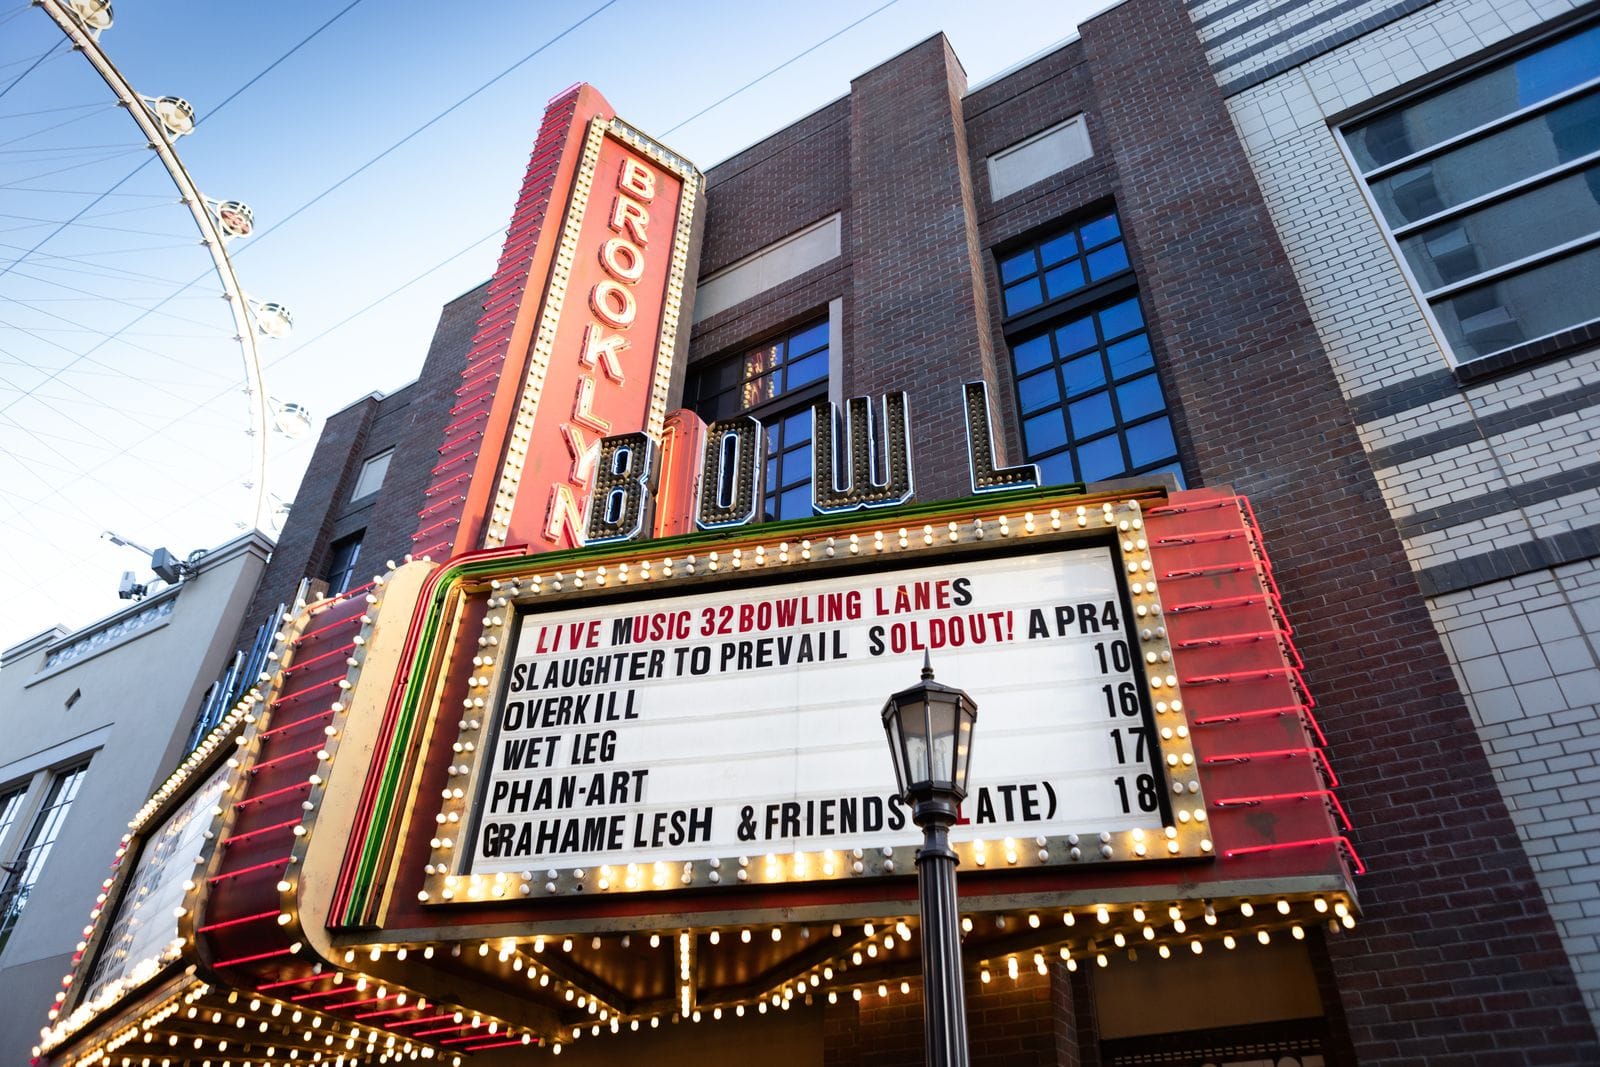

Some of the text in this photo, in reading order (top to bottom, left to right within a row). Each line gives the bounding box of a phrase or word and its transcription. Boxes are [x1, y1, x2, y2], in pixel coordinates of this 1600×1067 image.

[544, 156, 657, 549] BROOKLYN
[583, 380, 1041, 547] BOWL
[536, 620, 602, 654] LIVE
[612, 610, 692, 647] MUSIC
[876, 577, 973, 616] LANES
[503, 640, 1131, 731] OVERKILL 10
[510, 648, 665, 692] SLAUGHTER
[674, 645, 711, 676] TO
[720, 629, 848, 672] PREVAIL
[493, 726, 1148, 814] PHAN-ART 17
[502, 681, 1139, 771] WET LEG 16
[483, 814, 625, 858] GRAHAME
[633, 806, 713, 848] LESH
[1114, 773, 1159, 814] 18
